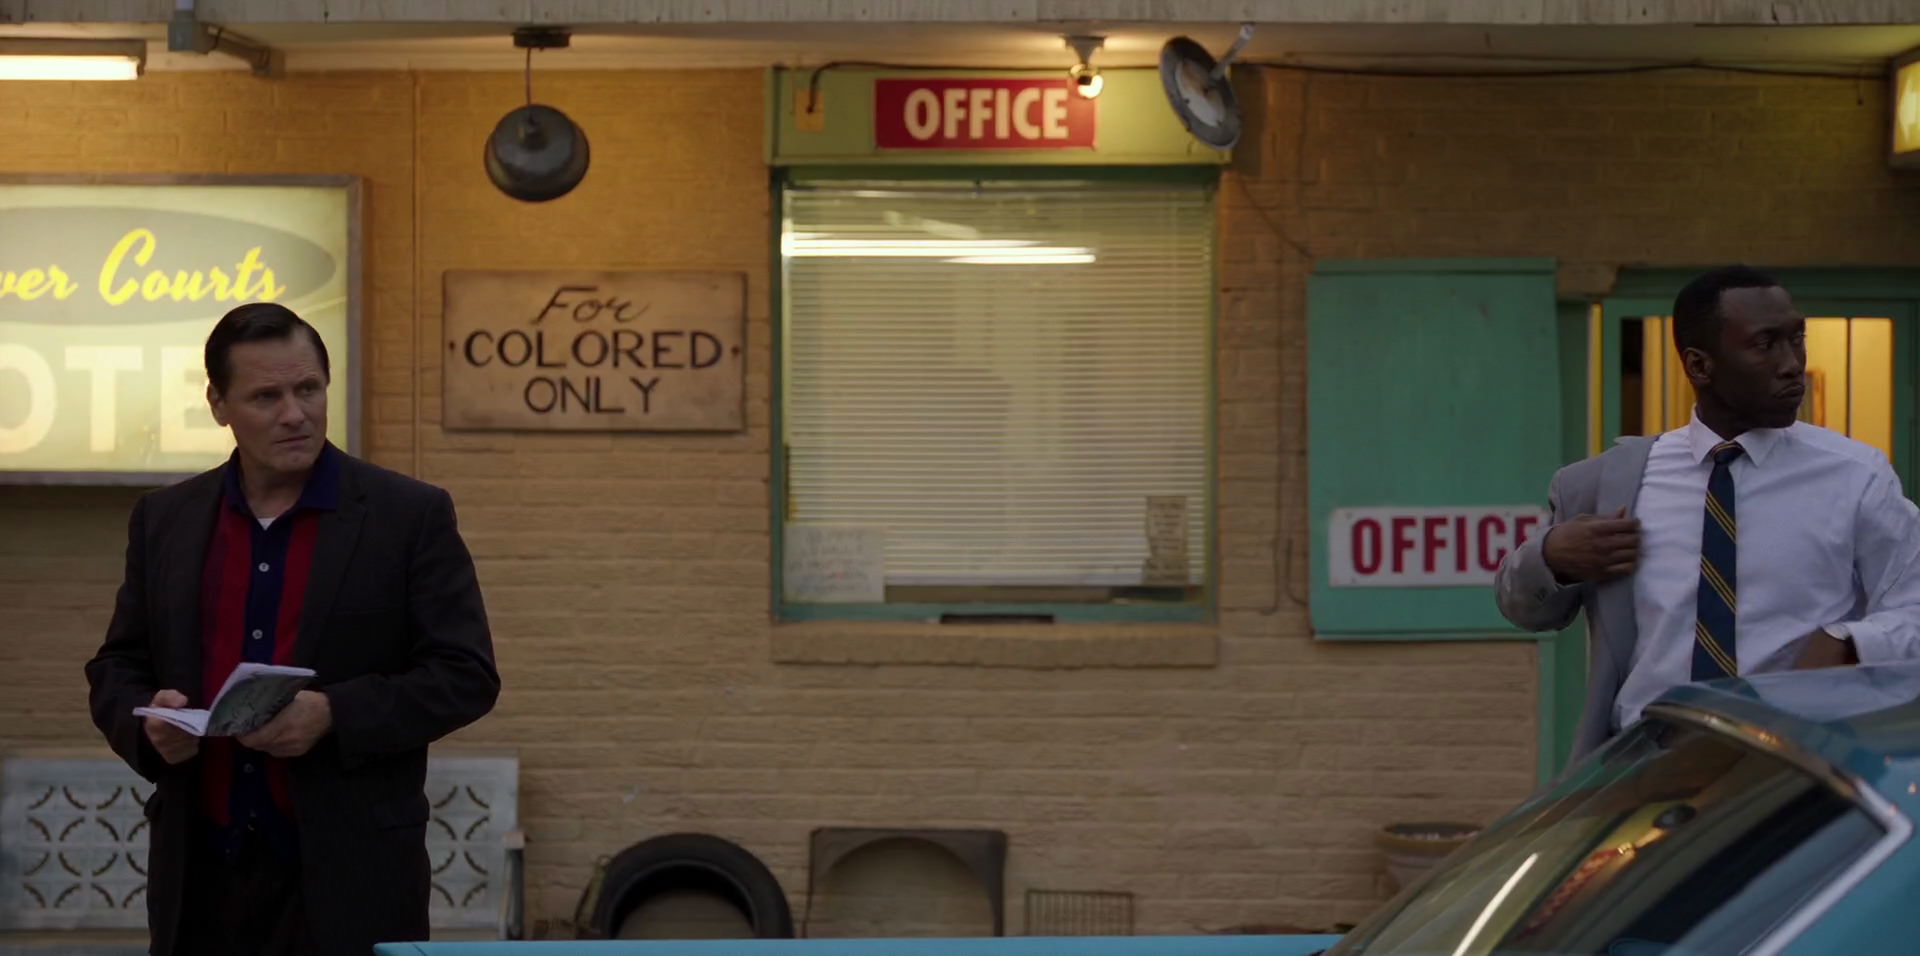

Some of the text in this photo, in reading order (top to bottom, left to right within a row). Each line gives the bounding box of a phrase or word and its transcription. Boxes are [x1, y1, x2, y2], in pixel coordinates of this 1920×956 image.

[904, 88, 1069, 140] OFFICE
[99, 228, 286, 306] Courts
[532, 285, 650, 325] For
[463, 329, 723, 369] COLORED
[524, 376, 659, 414] ONLY
